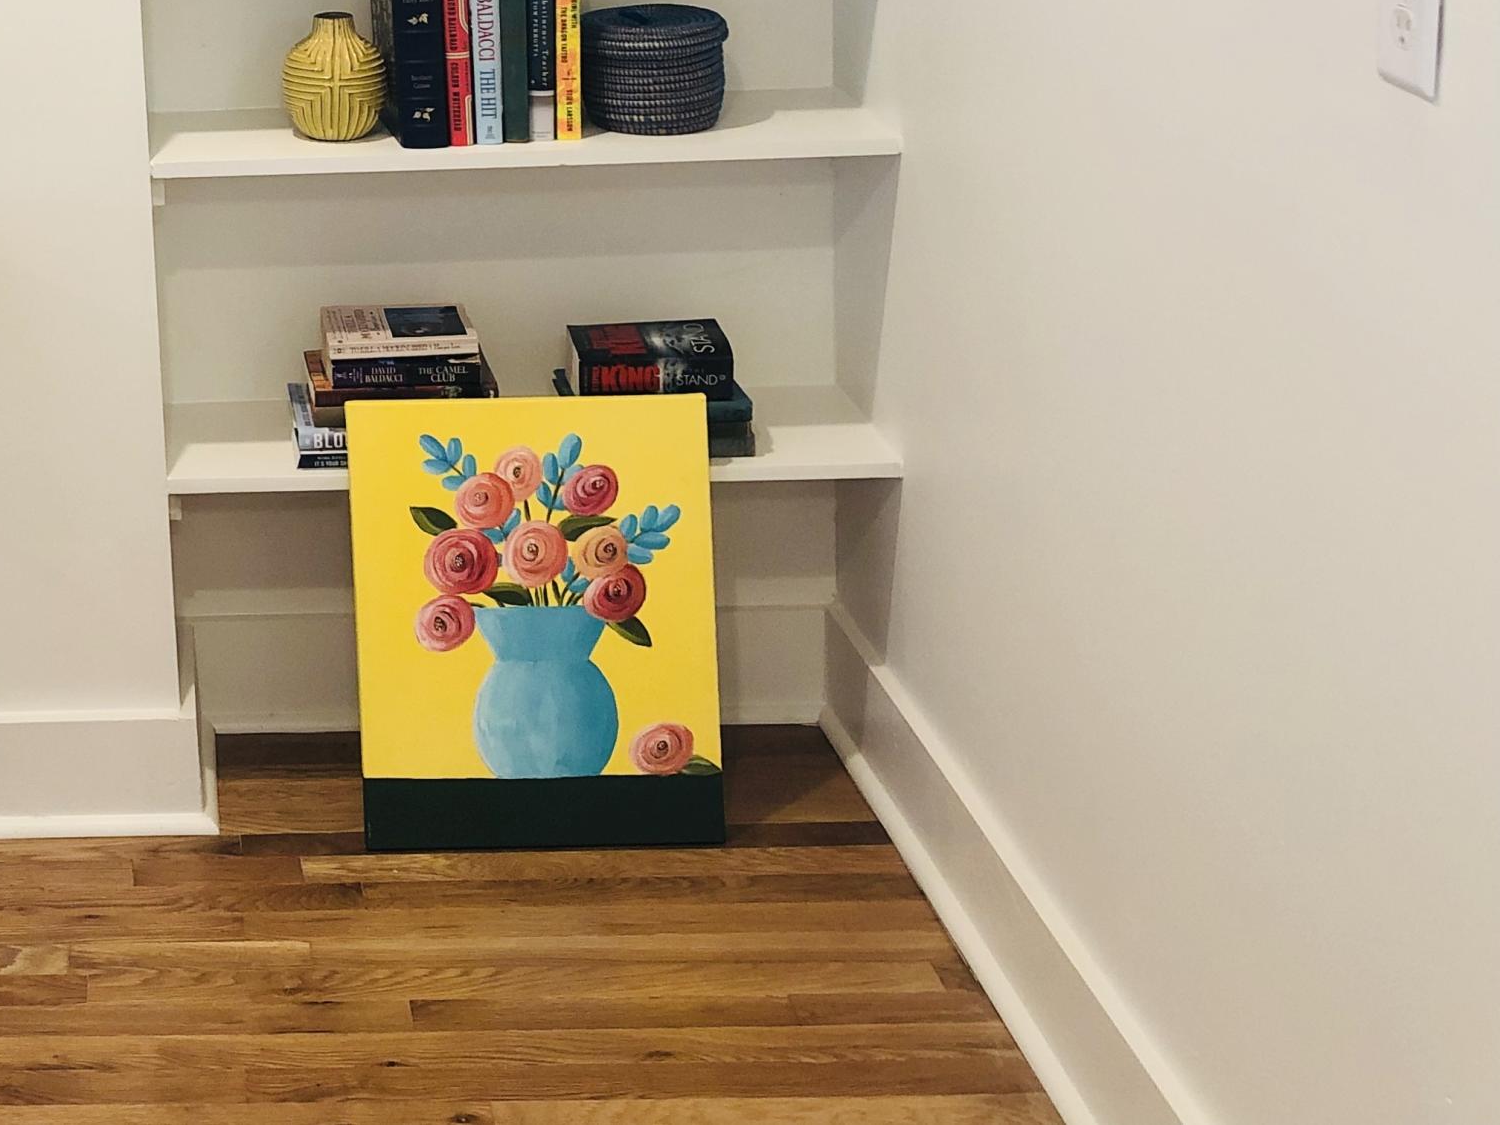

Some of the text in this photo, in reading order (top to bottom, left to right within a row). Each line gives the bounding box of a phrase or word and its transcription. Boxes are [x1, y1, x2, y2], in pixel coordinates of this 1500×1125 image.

[541, 49, 549, 87] Teacher
[479, 68, 496, 94] THE
[480, 97, 498, 119] HIT
[371, 366, 396, 375] DAVID
[418, 365, 469, 375] THE CAMEL
[365, 373, 403, 383] BALDACCI
[430, 373, 456, 383] CLUB
[600, 363, 661, 393] KING
[676, 374, 719, 386] STAND
[313, 432, 348, 449] BLO
